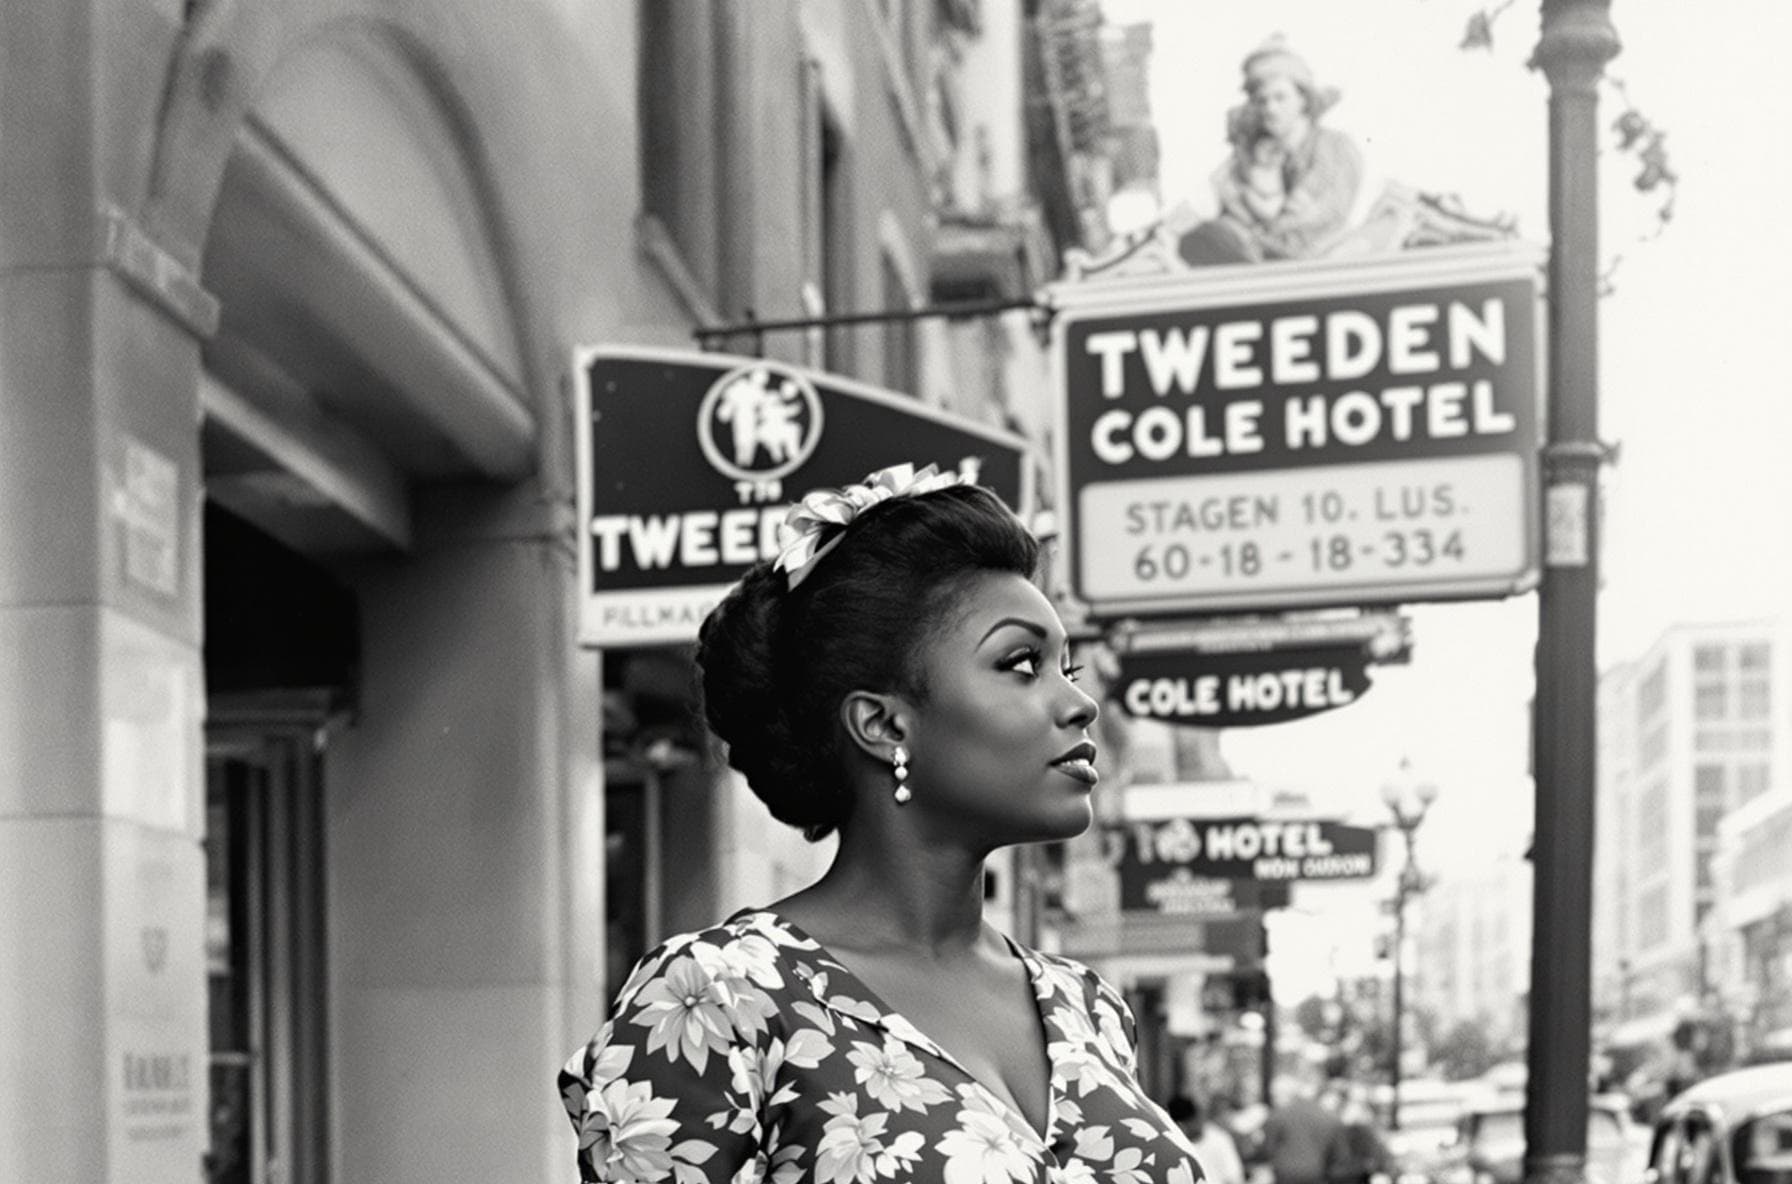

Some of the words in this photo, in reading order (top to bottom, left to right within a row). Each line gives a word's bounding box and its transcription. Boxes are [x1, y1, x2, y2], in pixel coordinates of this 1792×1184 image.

[1086, 298, 1505, 398] TWEEDEN
[1091, 401, 1264, 463] COLE
[1284, 380, 1515, 449] HOTEL
[1126, 494, 1279, 535] STAGEN
[1126, 676, 1220, 716] COLE
[1227, 668, 1353, 711] HOTEL
[1206, 823, 1333, 860] HOTEL
